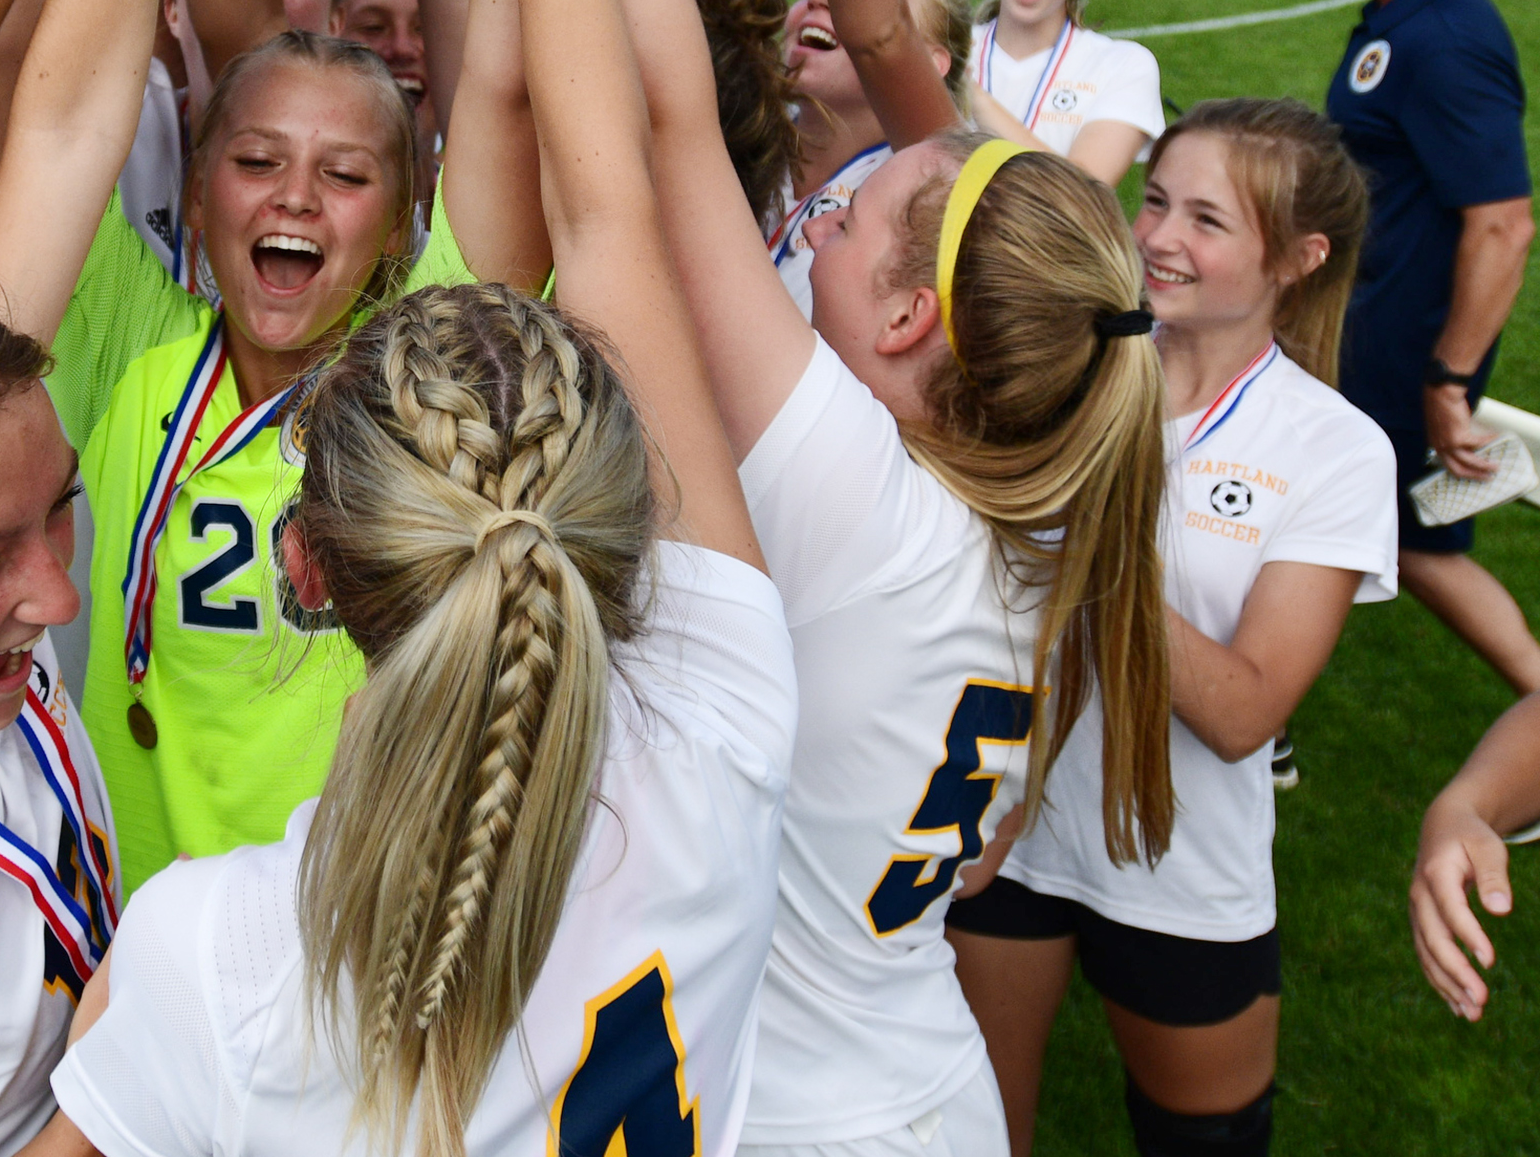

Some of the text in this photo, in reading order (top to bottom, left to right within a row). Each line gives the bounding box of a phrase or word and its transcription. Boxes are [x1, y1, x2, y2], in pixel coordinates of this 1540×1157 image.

[145, 211, 176, 253] adida
[1187, 460, 1289, 496] HARTLAND
[1185, 511, 1261, 545] SOCCER
[864, 678, 1052, 939] 5
